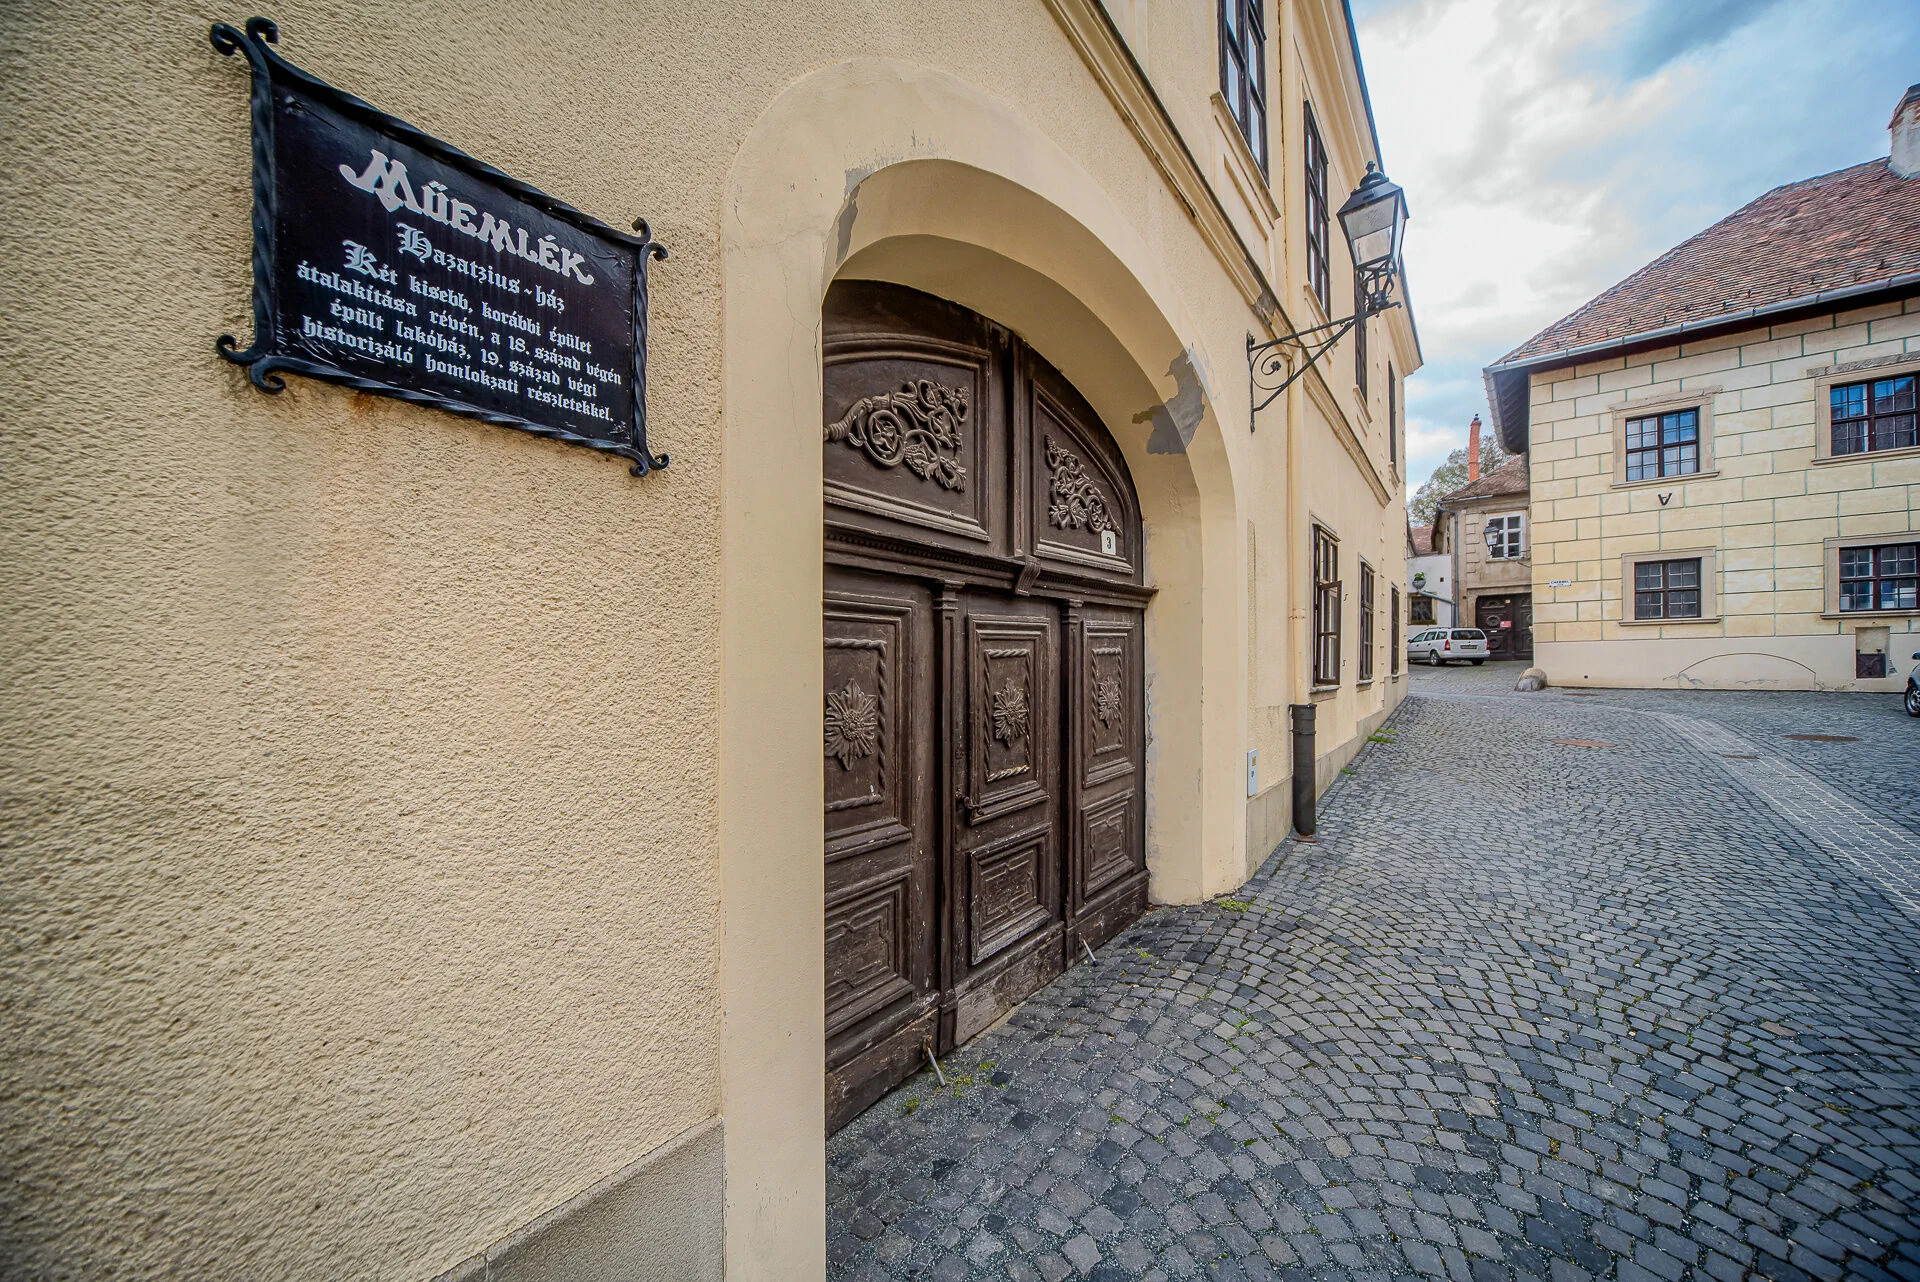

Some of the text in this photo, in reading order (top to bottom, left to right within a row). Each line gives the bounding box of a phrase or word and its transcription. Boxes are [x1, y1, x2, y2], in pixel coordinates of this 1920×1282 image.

[339, 149, 594, 285] MŰEMLÉK
[297, 260, 621, 385] átalakítása révén, a 18. század végén
[330, 298, 597, 397] épült lakóház, 19. század végi
[342, 239, 591, 354] Két kisebb, korábbi épület
[302, 315, 613, 422] historizáló homlokzati részletekkel.
[1106, 536, 1112, 550] 3
